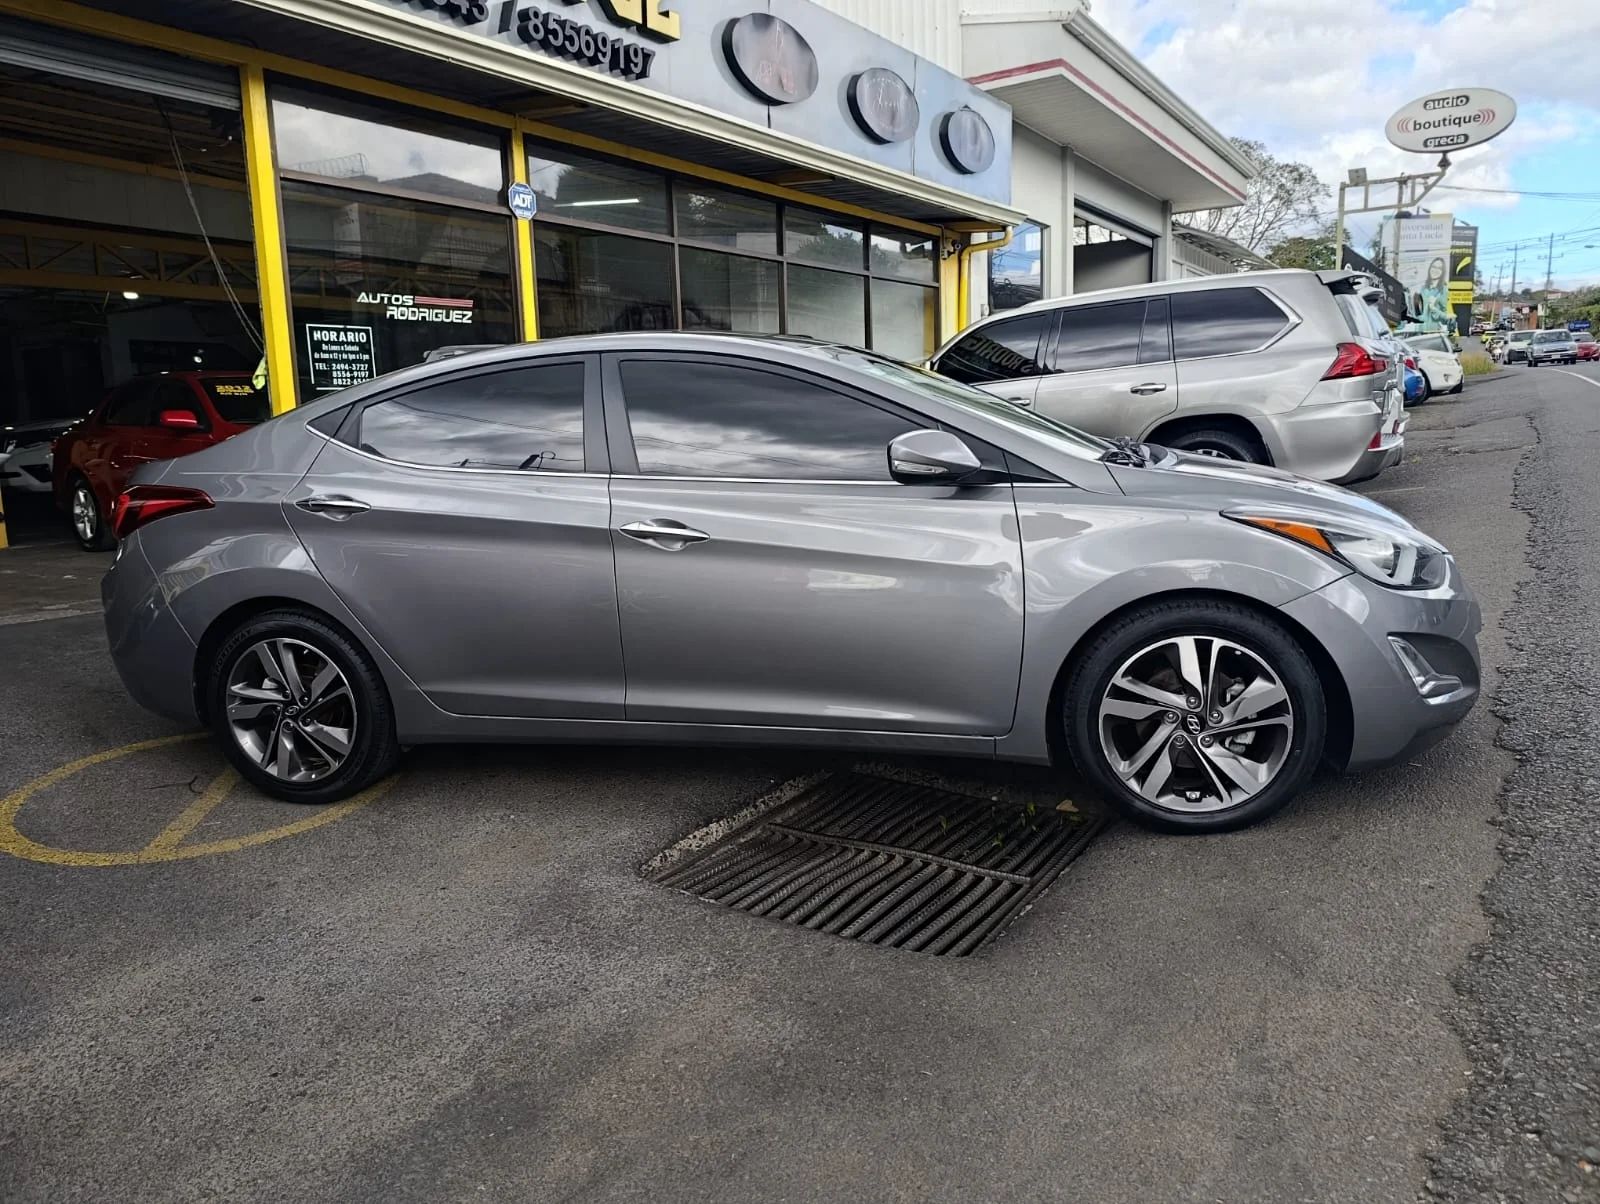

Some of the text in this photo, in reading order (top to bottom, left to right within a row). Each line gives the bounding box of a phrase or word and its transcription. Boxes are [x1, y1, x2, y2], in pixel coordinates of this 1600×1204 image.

[520, 6, 656, 78] 85569197
[1426, 95, 1467, 110] audio
[1413, 114, 1481, 131] boutique
[1427, 134, 1465, 148] grecia
[513, 192, 532, 209] ADT
[356, 292, 414, 306] AUTOS
[386, 306, 473, 323] RODRIGUEZ
[313, 330, 367, 343] HORARIO
[314, 362, 369, 371] TEL: 2494-3727
[332, 370, 369, 378] 8556-9197
